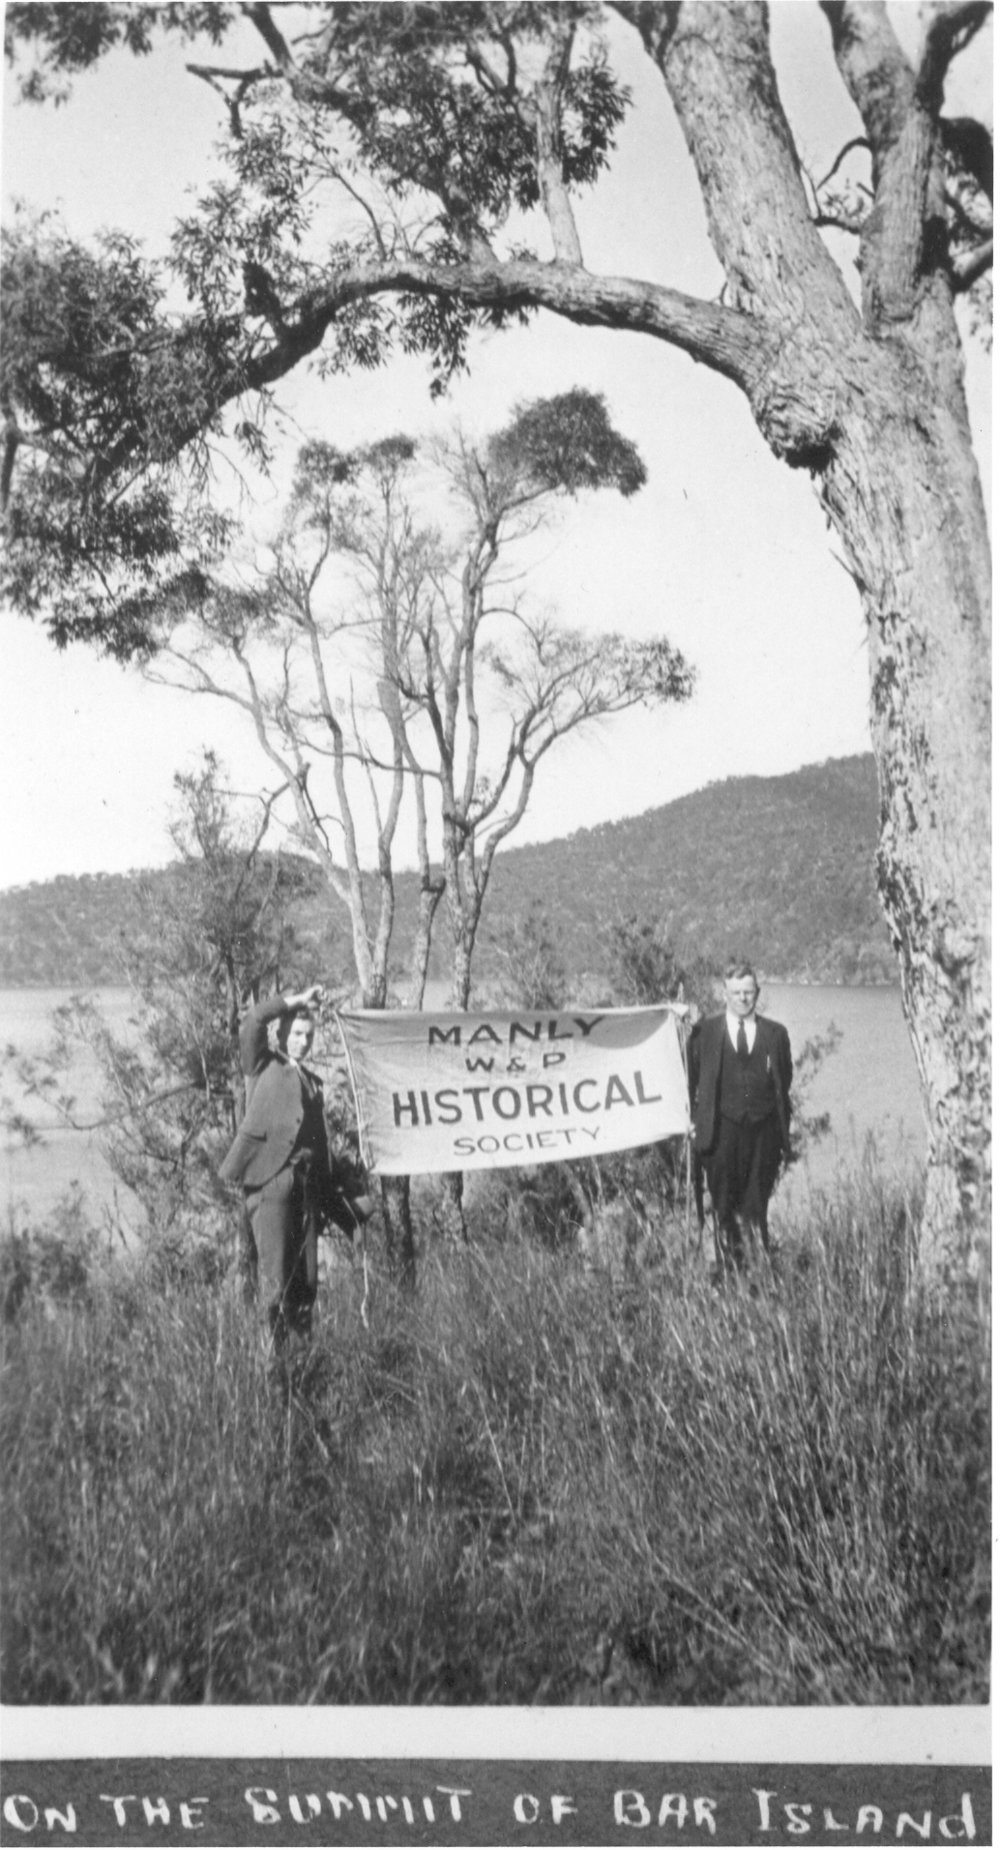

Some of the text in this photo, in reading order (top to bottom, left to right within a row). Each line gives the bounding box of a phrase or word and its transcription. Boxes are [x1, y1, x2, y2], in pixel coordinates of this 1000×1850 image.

[428, 1017, 605, 1046] MANLY
[465, 1051, 567, 1074] W & P
[391, 1070, 662, 1127] HISTORICAL
[453, 1126, 601, 1157] SOCIETY
